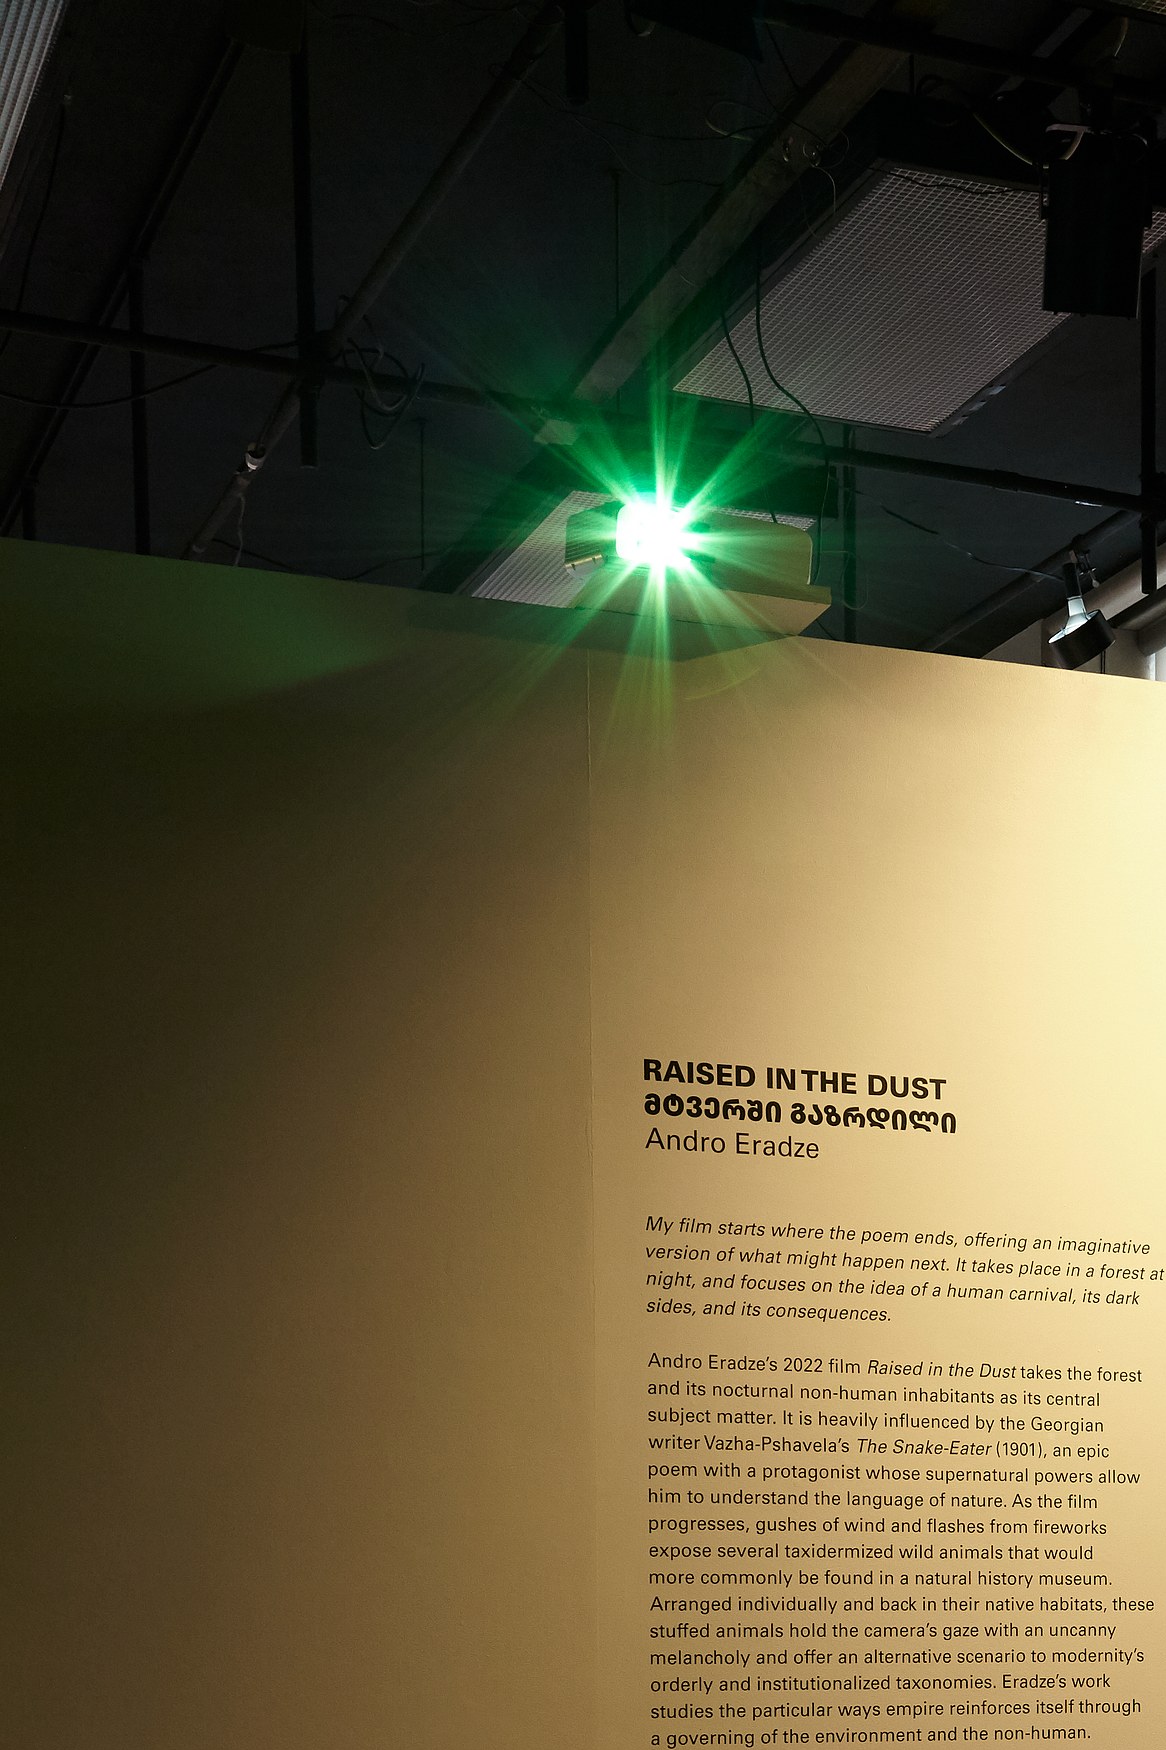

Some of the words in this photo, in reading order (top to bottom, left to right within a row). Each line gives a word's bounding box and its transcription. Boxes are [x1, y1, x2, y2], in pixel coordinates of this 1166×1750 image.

[643, 1058, 756, 1088] RAISED
[766, 1066, 796, 1091] IN
[800, 1069, 858, 1095] THE
[867, 1073, 947, 1101] DUST
[643, 1092, 782, 1124] მტვერში
[790, 1102, 957, 1134] გაზრდილი
[644, 1127, 726, 1154] Andro
[735, 1132, 820, 1159] Eradze
[645, 1215, 675, 1236] My
[678, 1217, 712, 1234] film
[717, 1221, 766, 1237] starts
[771, 1222, 824, 1240] where
[829, 1225, 856, 1241] the
[860, 1230, 909, 1245] poem
[914, 1230, 958, 1248] ends,
[964, 1231, 1028, 1253] offering
[1032, 1238, 1052, 1250] an
[1057, 1236, 1151, 1256] imaginative
[645, 1244, 711, 1261] version
[716, 1246, 736, 1262] of
[739, 1247, 783, 1264] what
[786, 1250, 838, 1270] might
[841, 1251, 905, 1272] happen
[910, 1258, 950, 1272] next.
[955, 1256, 968, 1273] It
[971, 1258, 1014, 1275] takes
[1018, 1260, 1061, 1278] place
[1066, 1262, 1081, 1277] in
[1085, 1266, 1095, 1278] a
[1100, 1263, 1146, 1281] forest
[1149, 1268, 1165, 1281] at
[645, 1270, 696, 1290] night,
[701, 1273, 736, 1289] and
[740, 1273, 806, 1292] focuses
[811, 1281, 833, 1293] on
[838, 1278, 865, 1295] the
[870, 1279, 905, 1296] idea
[910, 1281, 930, 1297] of
[931, 1286, 942, 1298] a
[946, 1282, 1004, 1300] human
[1009, 1286, 1077, 1305] carnival,
[1082, 1288, 1101, 1304] its
[1105, 1289, 1141, 1306] dark
[645, 1297, 697, 1317] sides,
[702, 1300, 737, 1316] and
[740, 1300, 762, 1317] its
[766, 1305, 891, 1323] consequences.
[647, 1352, 703, 1370] Andro
[783, 1357, 823, 1373] 2022
[827, 1357, 861, 1374] film
[867, 1359, 924, 1376] Raised
[927, 1361, 943, 1377] in
[948, 1362, 975, 1378] the
[979, 1362, 1017, 1379] Dust
[1019, 1364, 1062, 1380] takes
[1066, 1365, 1092, 1382] the
[1096, 1366, 1143, 1383] forest
[647, 1380, 680, 1396] and
[686, 1380, 707, 1397] its
[712, 1383, 794, 1399] nocturnal
[800, 1384, 897, 1402] non-human
[903, 1386, 995, 1404] inhabitants
[999, 1393, 1018, 1405] as
[1023, 1390, 1042, 1406] its
[1046, 1392, 1100, 1407] central
[647, 1406, 712, 1427] subject
[716, 1410, 777, 1425] matter.
[783, 1409, 794, 1426] It
[798, 1410, 813, 1426] is
[818, 1410, 879, 1431] heavily
[884, 1412, 970, 1430] influenced
[975, 1414, 995, 1434] by
[999, 1415, 1026, 1431] the
[1030, 1416, 1104, 1436] Georgian
[648, 1435, 701, 1451] writer
[857, 1438, 888, 1454] The
[892, 1438, 993, 1456] Snake-Eater
[996, 1440, 1047, 1459] (1901),
[1052, 1446, 1072, 1458] an
[1077, 1443, 1110, 1462] epic
[648, 1487, 681, 1504] him
[686, 1490, 705, 1504] to
[710, 1489, 809, 1506] understand
[813, 1490, 841, 1506] the
[847, 1490, 924, 1511] language
[929, 1491, 946, 1507] of
[951, 1494, 1007, 1508] nature.
[1011, 1493, 1033, 1509] As
[1036, 1493, 1063, 1509] the
[1067, 1493, 1098, 1509] film
[648, 1518, 750, 1535] progresses,
[755, 1516, 817, 1536] gushes
[822, 1516, 840, 1532] of
[843, 1517, 885, 1533] wind
[890, 1517, 922, 1533] and
[926, 1517, 985, 1534] flashes
[989, 1518, 1028, 1534] from
[1032, 1519, 1107, 1535] fireworks
[649, 1572, 695, 1585] more
[700, 1569, 793, 1589] commonly
[798, 1569, 819, 1585] be
[823, 1569, 874, 1585] found
[879, 1570, 894, 1585] in
[899, 1573, 909, 1586] a
[915, 1570, 972, 1586] natural
[977, 1570, 1034, 1589] history
[1039, 1574, 1113, 1586] museum.
[649, 1595, 732, 1615] Arranged
[737, 1595, 838, 1615] individually
[843, 1596, 874, 1612] and
[880, 1596, 917, 1612] back
[922, 1596, 937, 1612] in
[941, 1596, 981, 1612] their
[985, 1596, 1035, 1612] native
[1039, 1596, 1107, 1614] habitats,
[1111, 1596, 1155, 1612] these
[649, 1622, 710, 1639] stuffed
[715, 1622, 784, 1639] animals
[789, 1622, 827, 1638] hold
[831, 1622, 859, 1638] the
[942, 1626, 979, 1641] gaze
[983, 1622, 1019, 1637] with
[1024, 1625, 1044, 1638] an
[1049, 1625, 1117, 1640] uncanny
[650, 1649, 751, 1669] melancholy
[755, 1649, 788, 1665] and
[793, 1648, 834, 1665] offer
[837, 1652, 858, 1665] an
[863, 1648, 952, 1665] alternative
[956, 1648, 1026, 1664] scenario
[1030, 1649, 1047, 1663] to
[650, 1676, 714, 1696] orderly
[718, 1675, 751, 1692] and
[757, 1674, 891, 1692] institutionalized
[895, 1674, 997, 1690] taxonomies.
[1071, 1673, 1111, 1689] work
[650, 1734, 660, 1746] a
[666, 1729, 755, 1750] governing
[760, 1728, 779, 1745] of
[782, 1728, 810, 1744] the
[815, 1727, 923, 1744] environment
[927, 1726, 958, 1742] and
[962, 1725, 989, 1741] the
[994, 1725, 1091, 1741] non-human.
